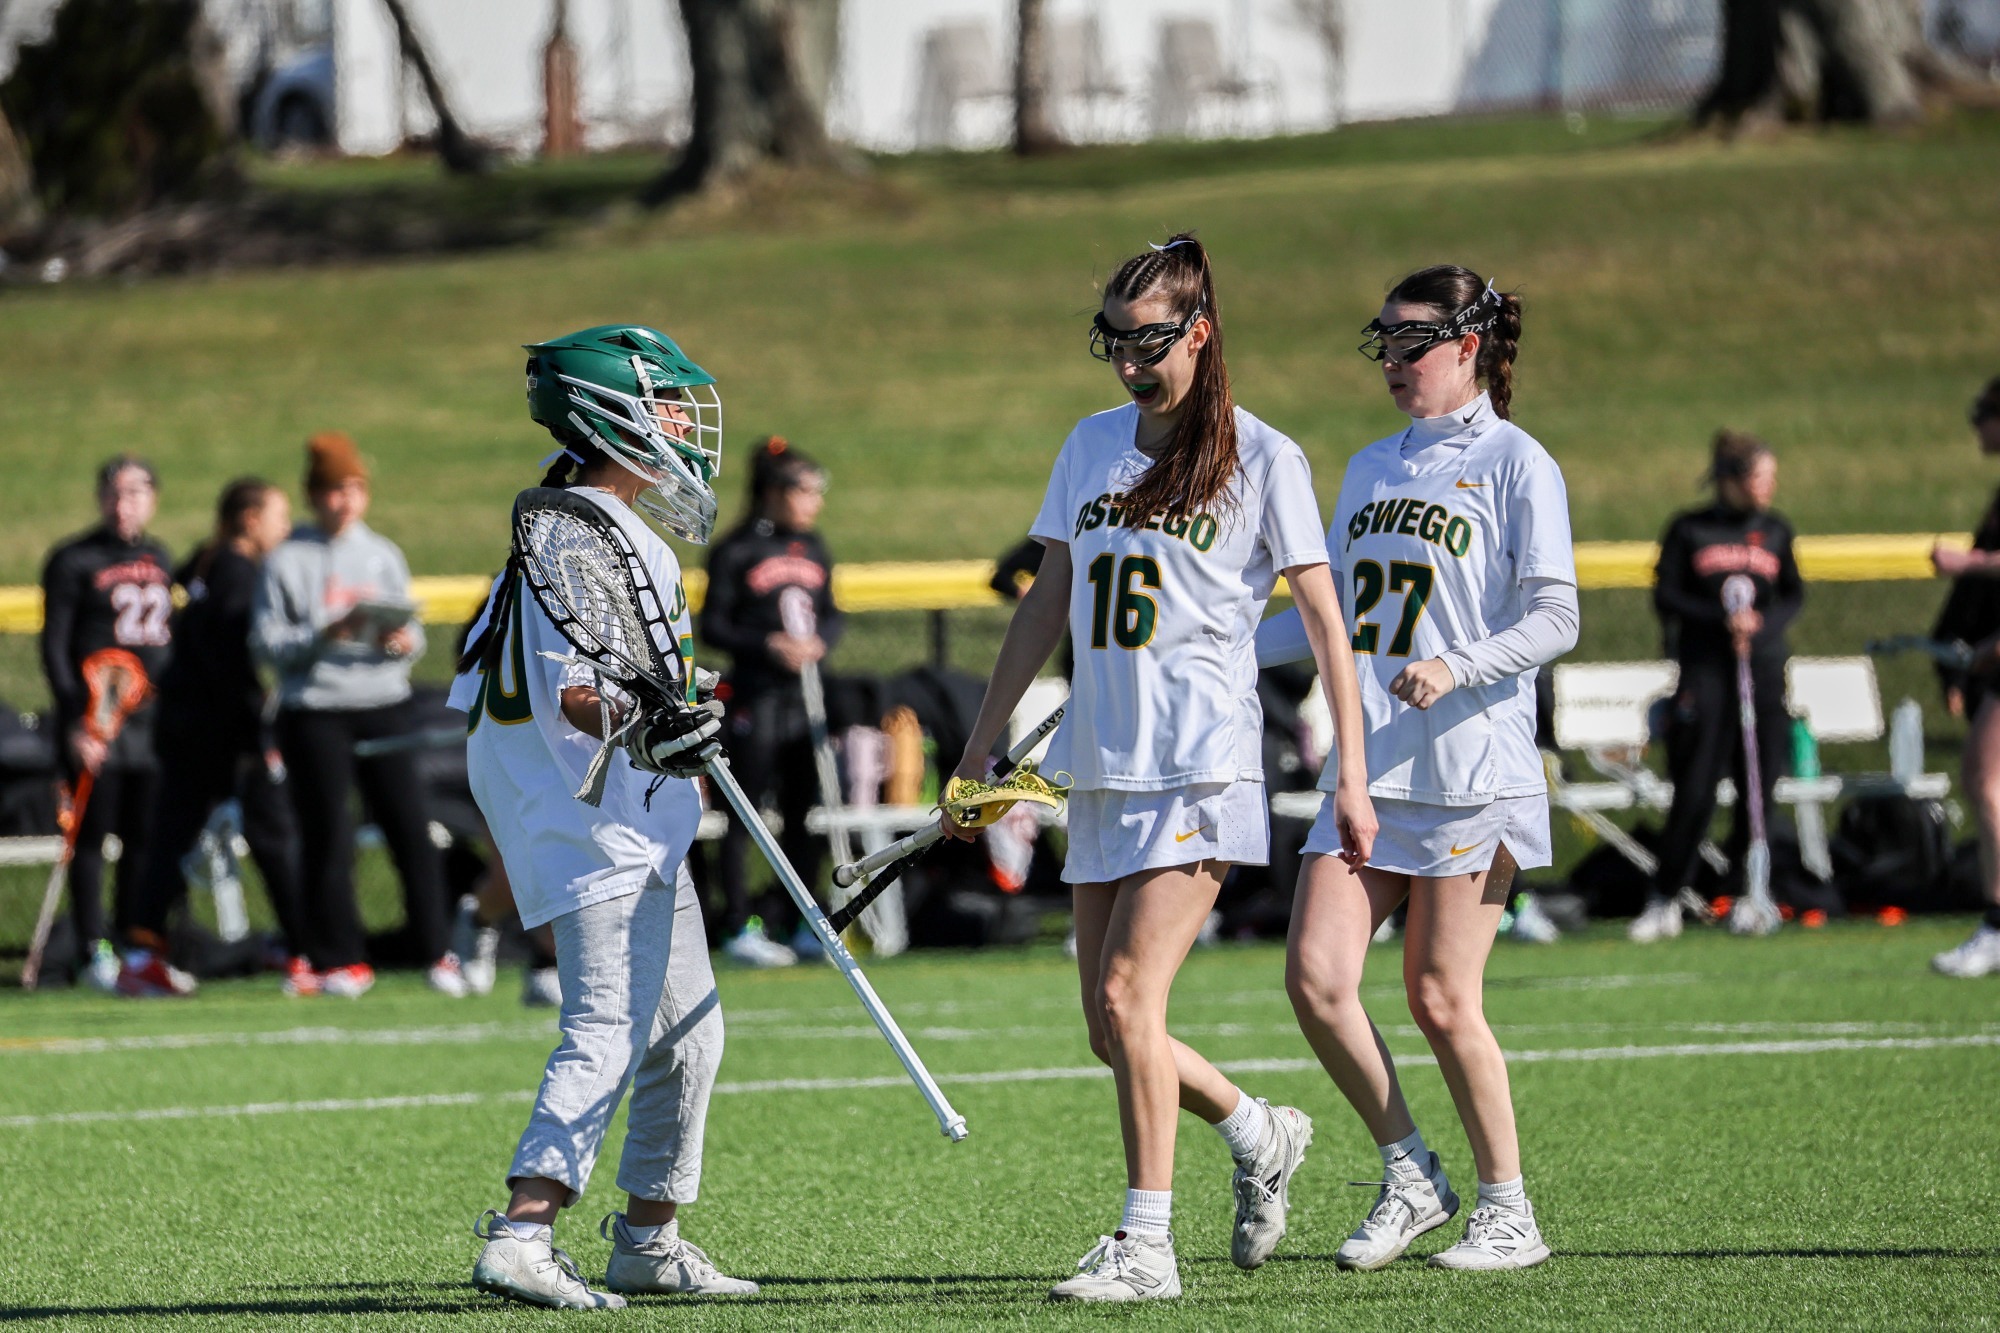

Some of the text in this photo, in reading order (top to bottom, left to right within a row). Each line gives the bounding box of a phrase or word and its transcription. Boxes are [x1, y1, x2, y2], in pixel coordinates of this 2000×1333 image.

[1185, 306, 1201, 333] STX
[1456, 302, 1480, 325] STX
[1460, 322, 1483, 335] STX
[111, 582, 172, 646] 22
[1088, 552, 1162, 650] 16
[1351, 558, 1436, 658] 27
[1037, 707, 1065, 737] GAIT
